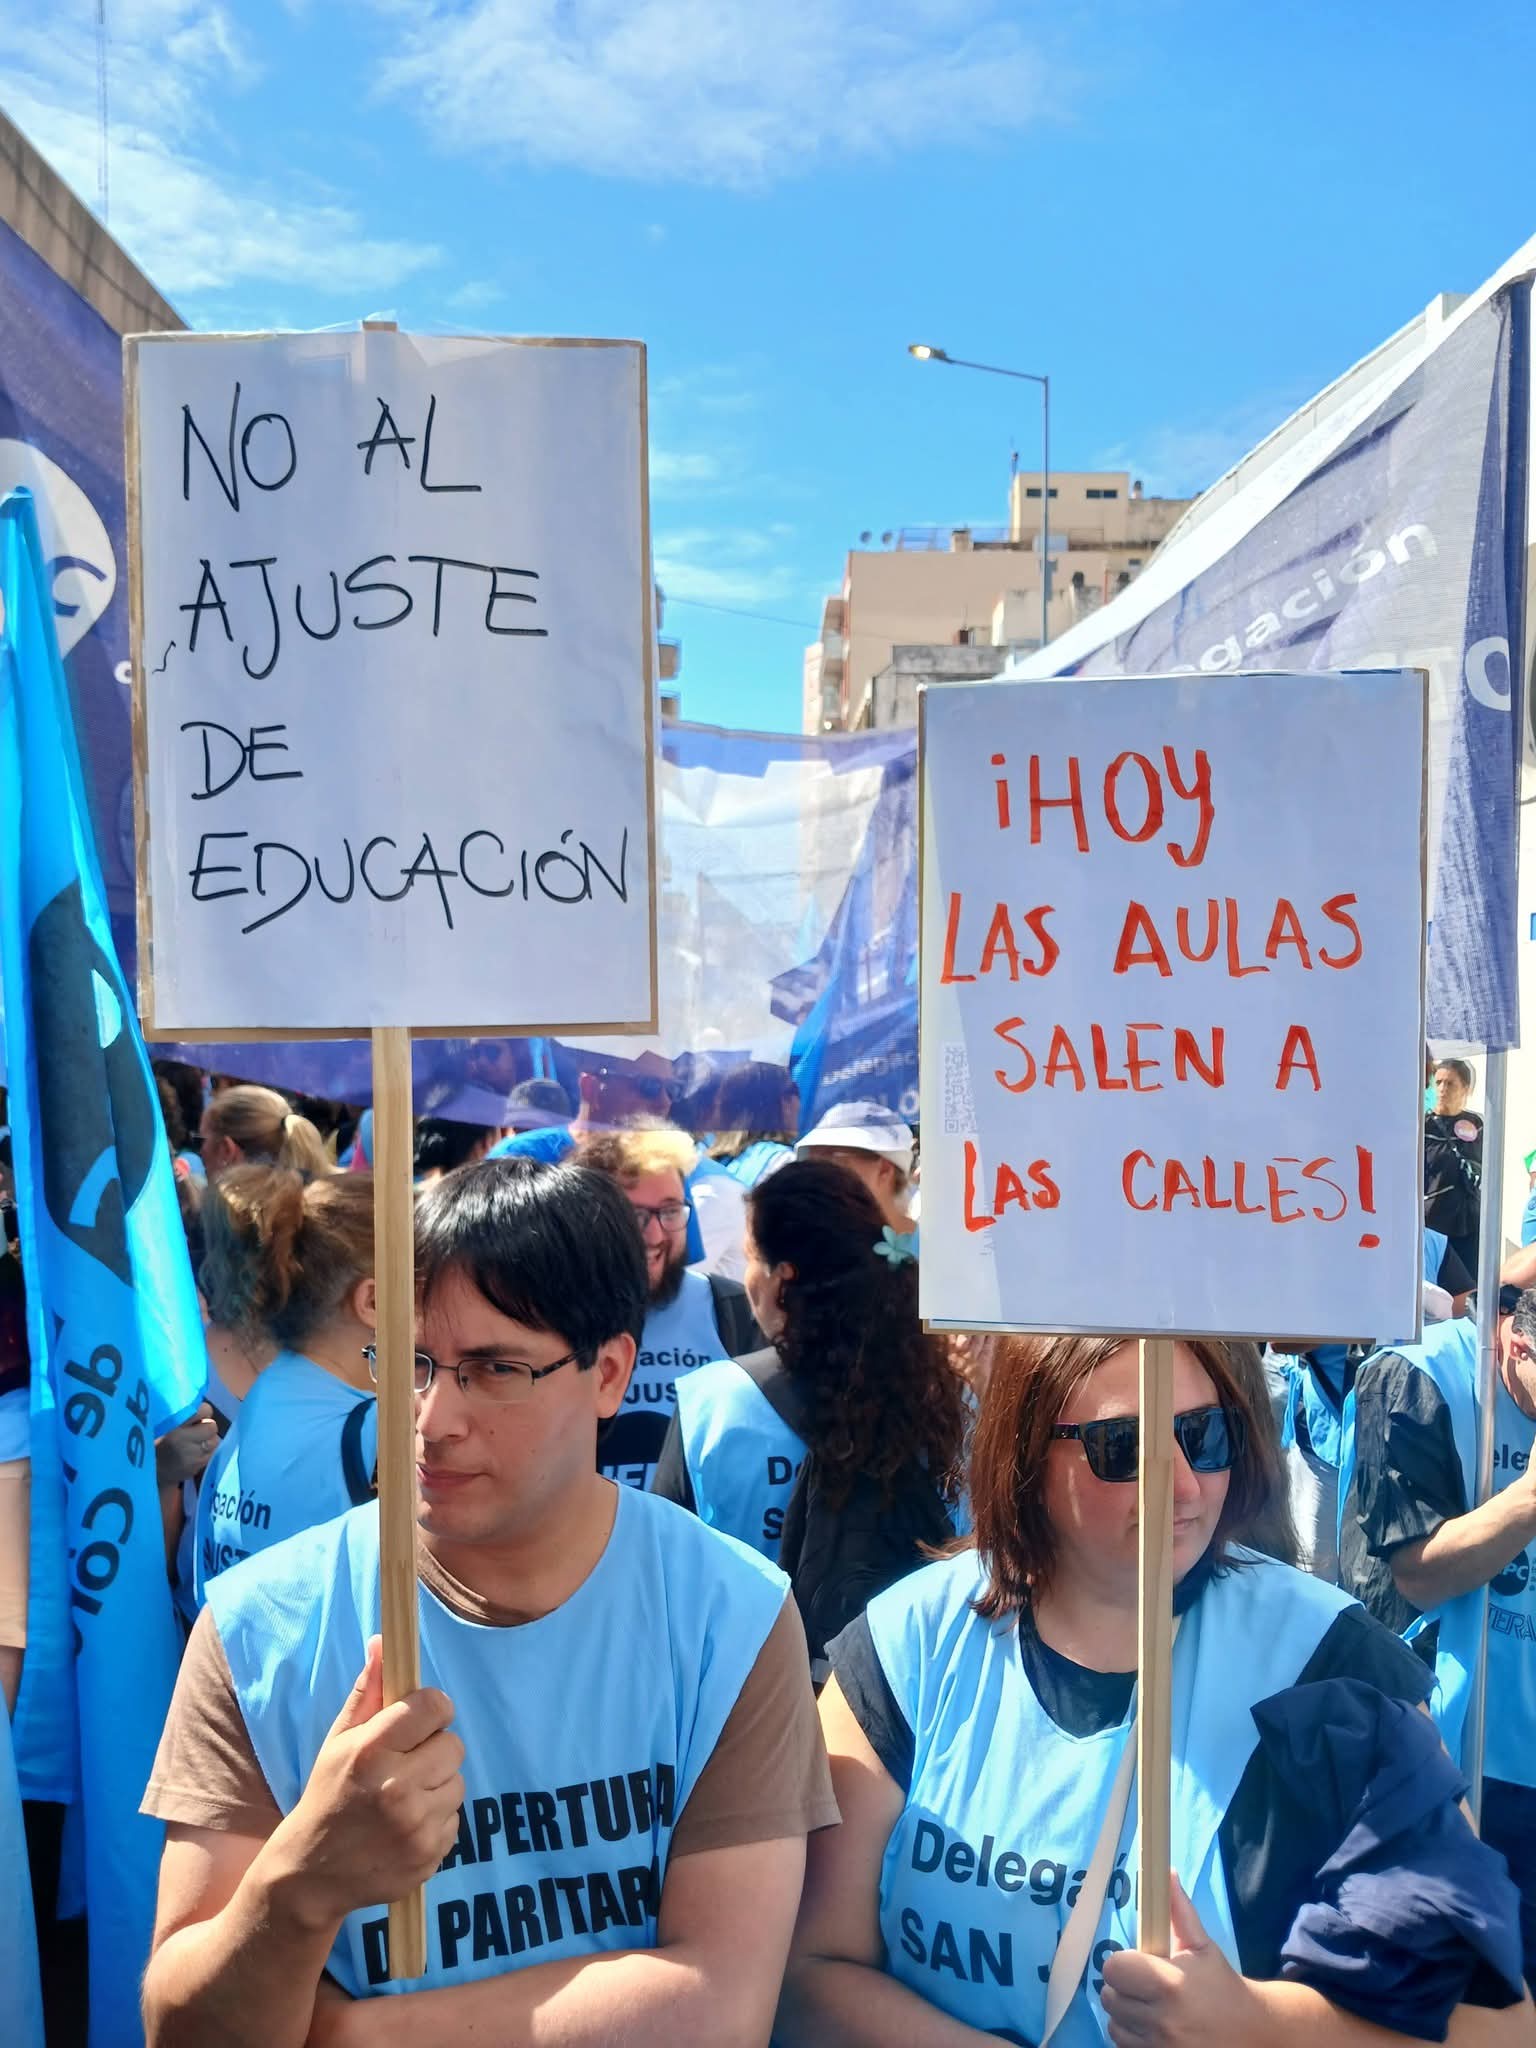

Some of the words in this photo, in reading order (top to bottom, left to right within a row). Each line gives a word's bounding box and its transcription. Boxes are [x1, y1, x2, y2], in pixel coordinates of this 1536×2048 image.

[182, 383, 297, 512] NO
[358, 395, 482, 492] AL
[180, 556, 548, 679] AJUSTE
[1172, 524, 1438, 672] gación
[181, 722, 303, 800] DE
[189, 830, 628, 934] EDUCACIÓN
[940, 893, 1060, 985] LAS
[1114, 894, 1363, 978] AULAS
[995, 1018, 1225, 1093] SALEN
[1276, 1025, 1321, 1091] A
[964, 1141, 1060, 1233] LAS
[1122, 1146, 1380, 1249] CALLES!
[639, 1347, 712, 1368] ación
[435, 1763, 676, 1873] APERTURA
[900, 1907, 1014, 1987] SAN
